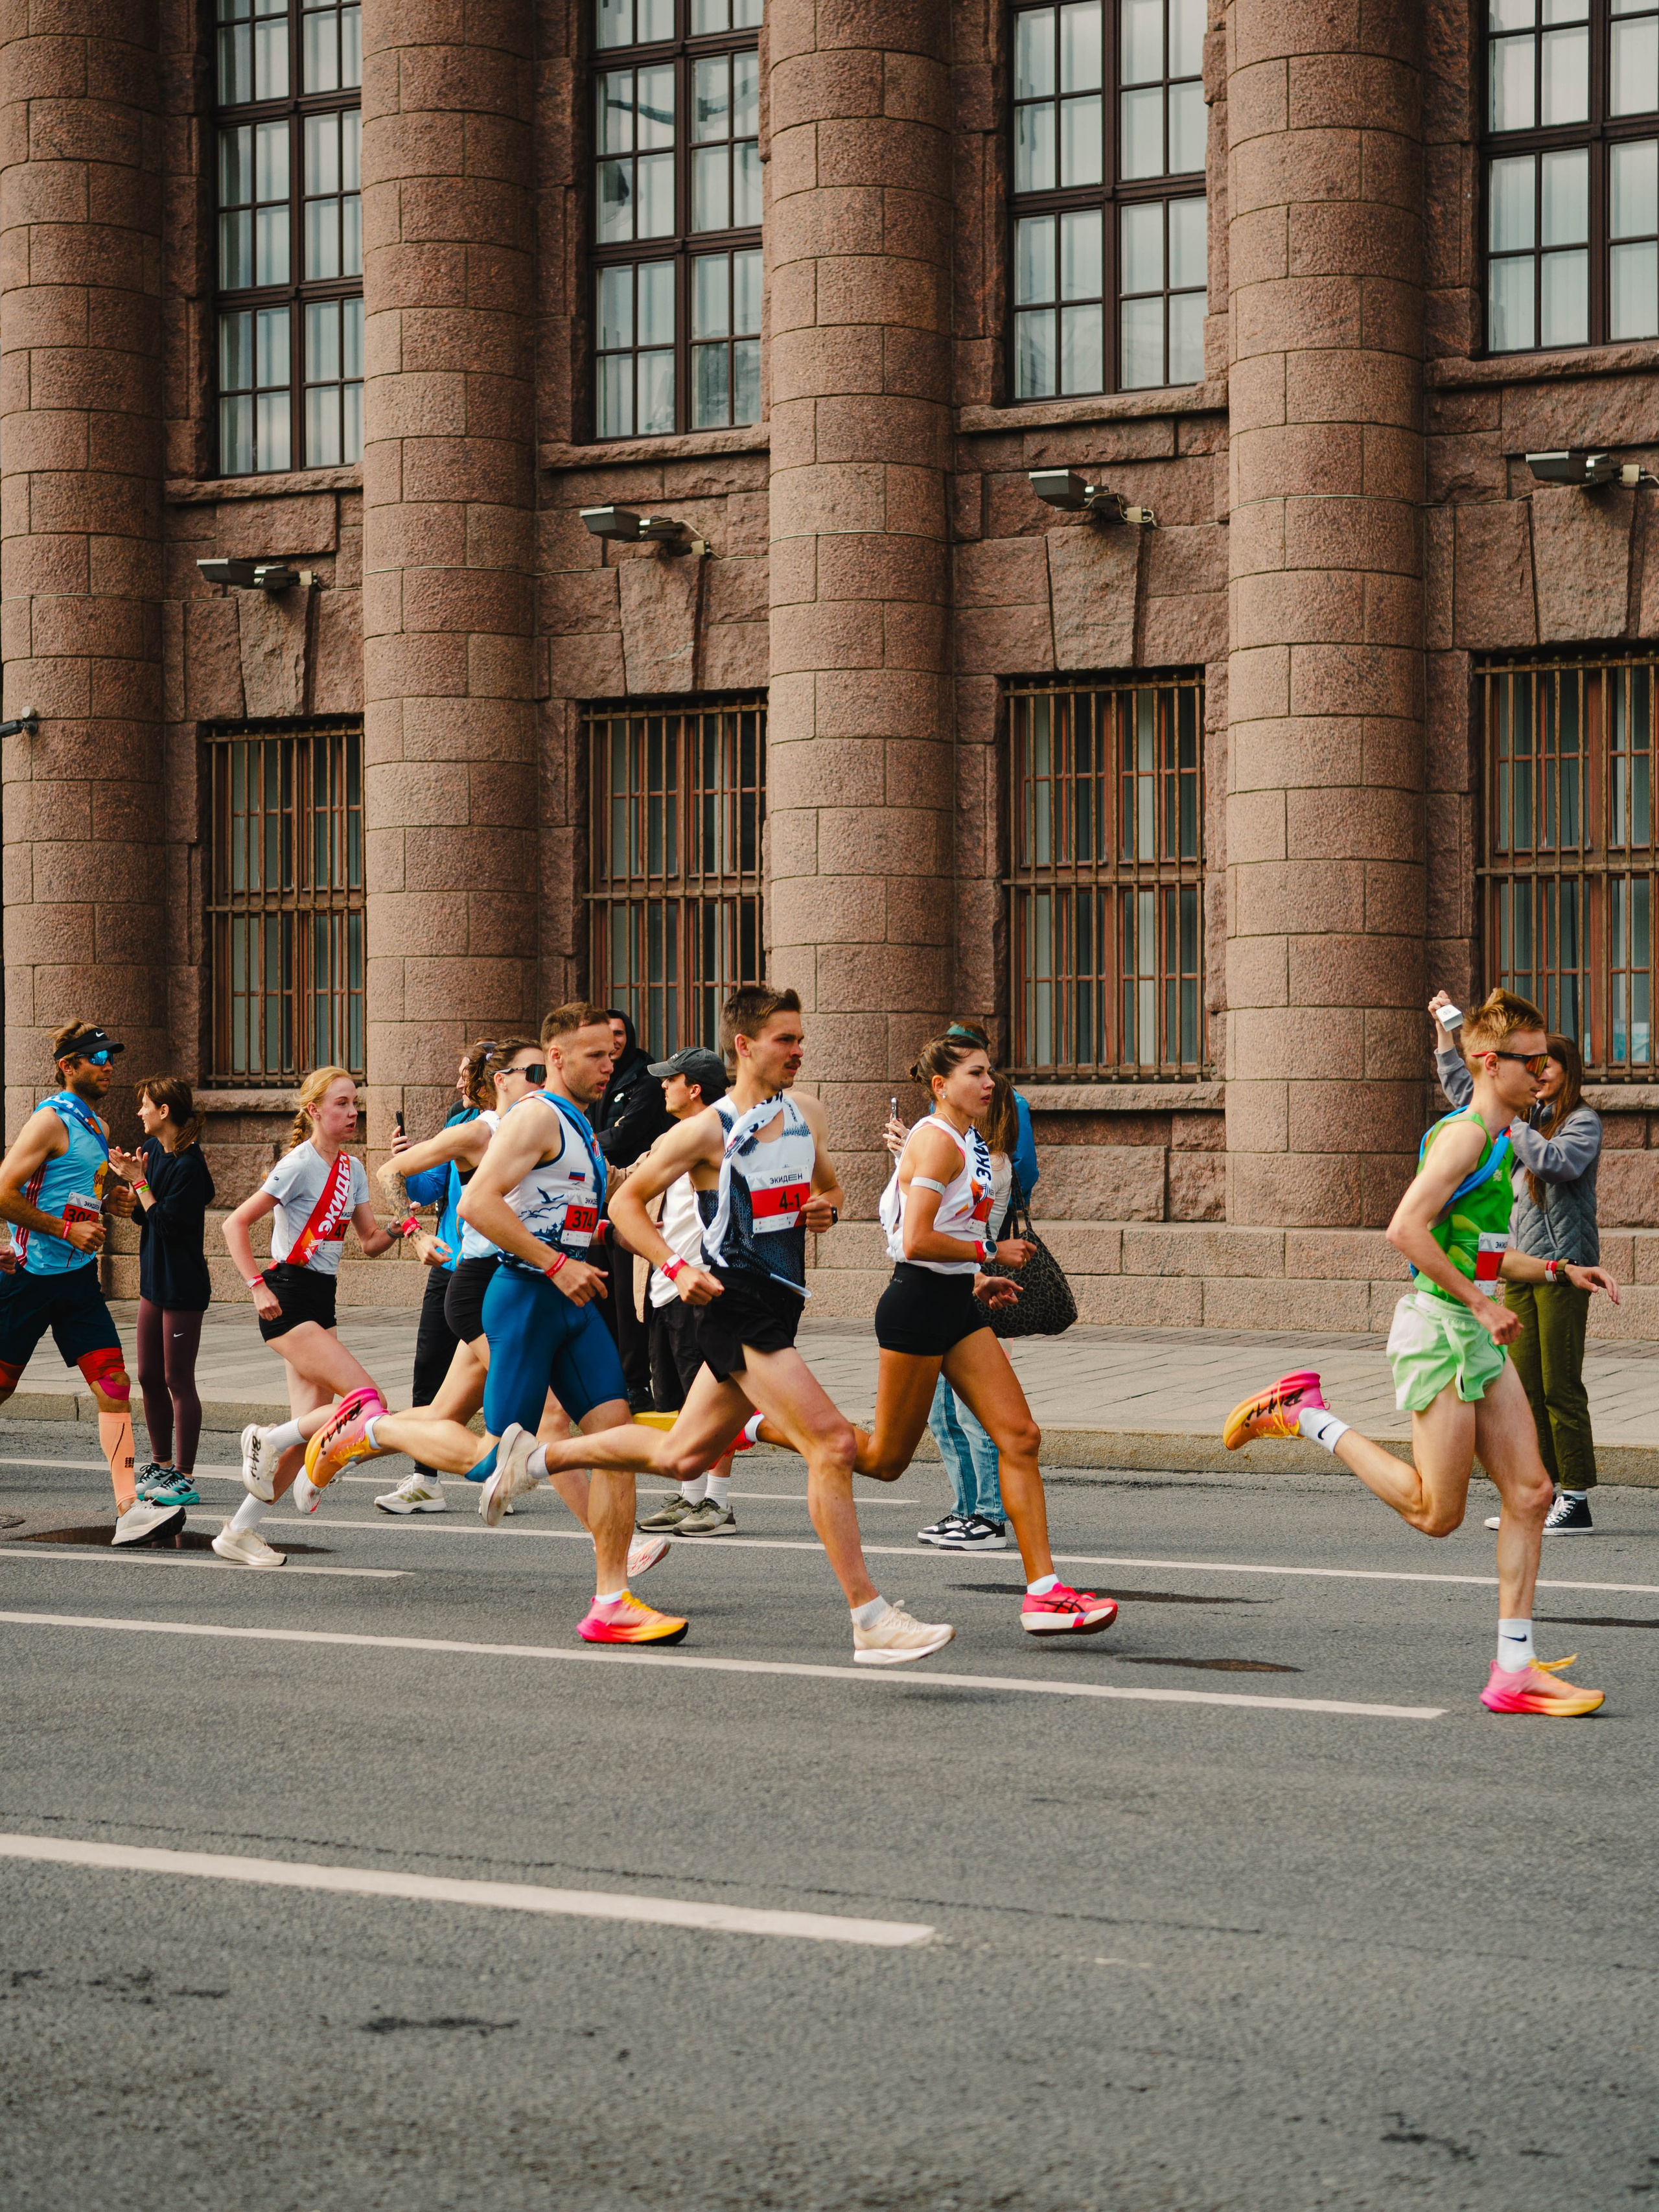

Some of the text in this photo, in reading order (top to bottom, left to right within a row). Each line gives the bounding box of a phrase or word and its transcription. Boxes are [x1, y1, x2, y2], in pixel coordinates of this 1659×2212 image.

[973, 1129, 992, 1181] ЭКИ
[770, 1172, 803, 1184] ЭКИДЕН
[780, 1191, 800, 1210] 4-1
